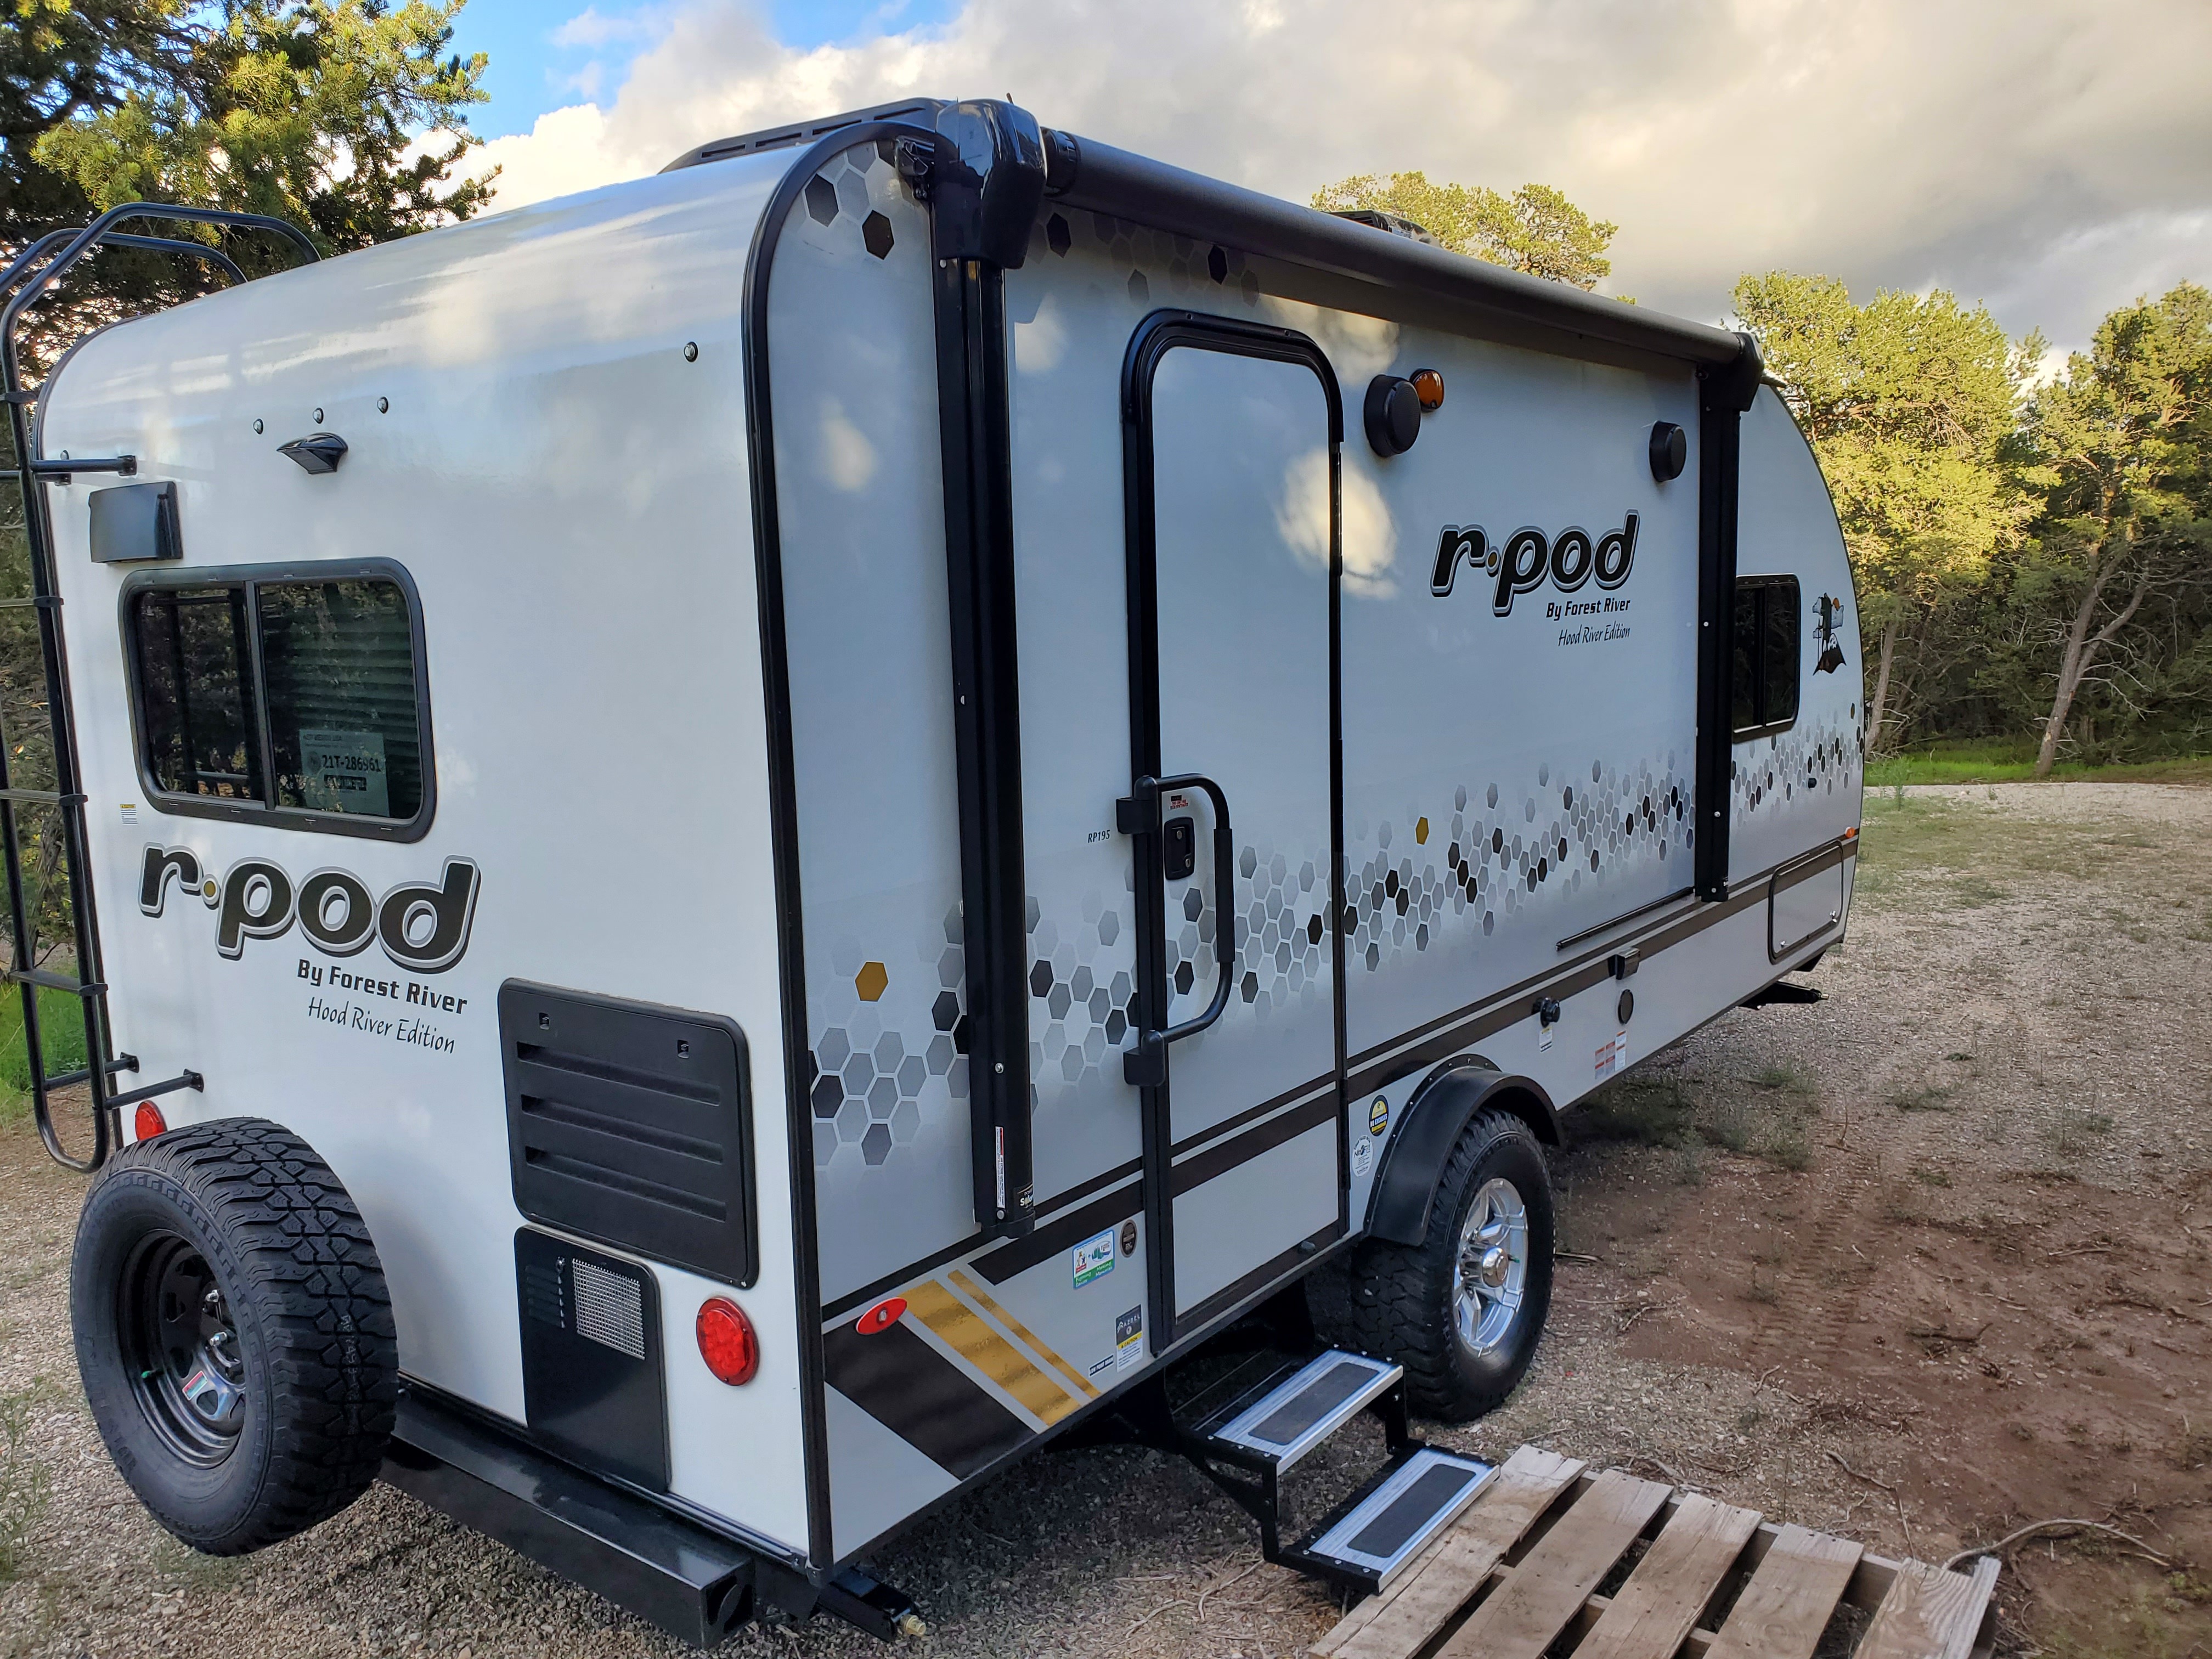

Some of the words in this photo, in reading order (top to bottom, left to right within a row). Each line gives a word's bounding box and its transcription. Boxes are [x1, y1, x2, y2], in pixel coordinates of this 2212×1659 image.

[1546, 602, 1561, 621] By
[1565, 600, 1601, 617] Forest
[1604, 597, 1630, 613] River
[1558, 624, 1582, 646] Hood
[1583, 627, 1604, 644] River
[1604, 621, 1630, 641] Edition
[1088, 830, 1110, 843] RP195
[297, 959, 321, 987] By
[329, 966, 399, 1000] Forest
[407, 982, 468, 1014] River
[308, 997, 349, 1026] Hood
[352, 1007, 392, 1036] River
[397, 1018, 455, 1054] Edition
